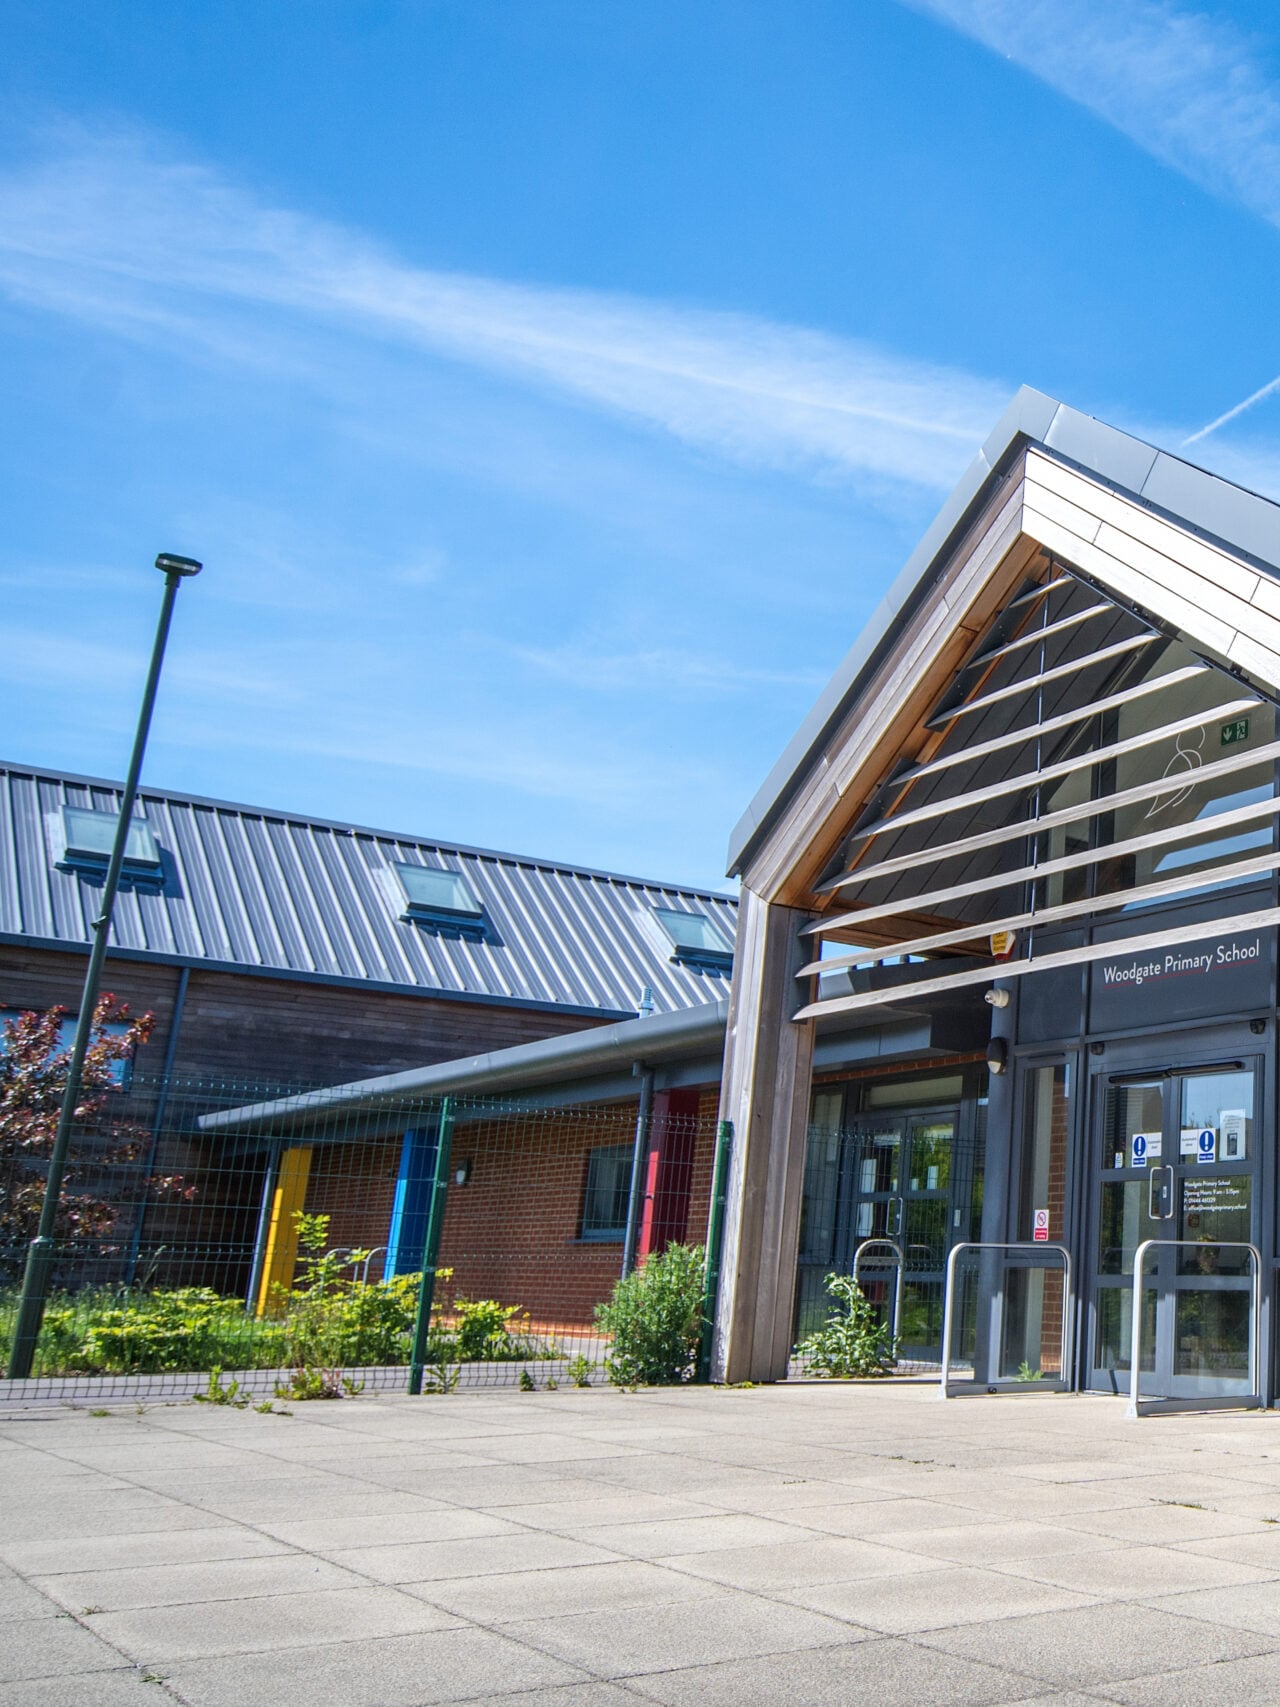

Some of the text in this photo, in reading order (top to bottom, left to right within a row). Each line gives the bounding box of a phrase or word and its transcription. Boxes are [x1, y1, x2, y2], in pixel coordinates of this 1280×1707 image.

[1104, 938, 1260, 985] Woodgate Primary School
